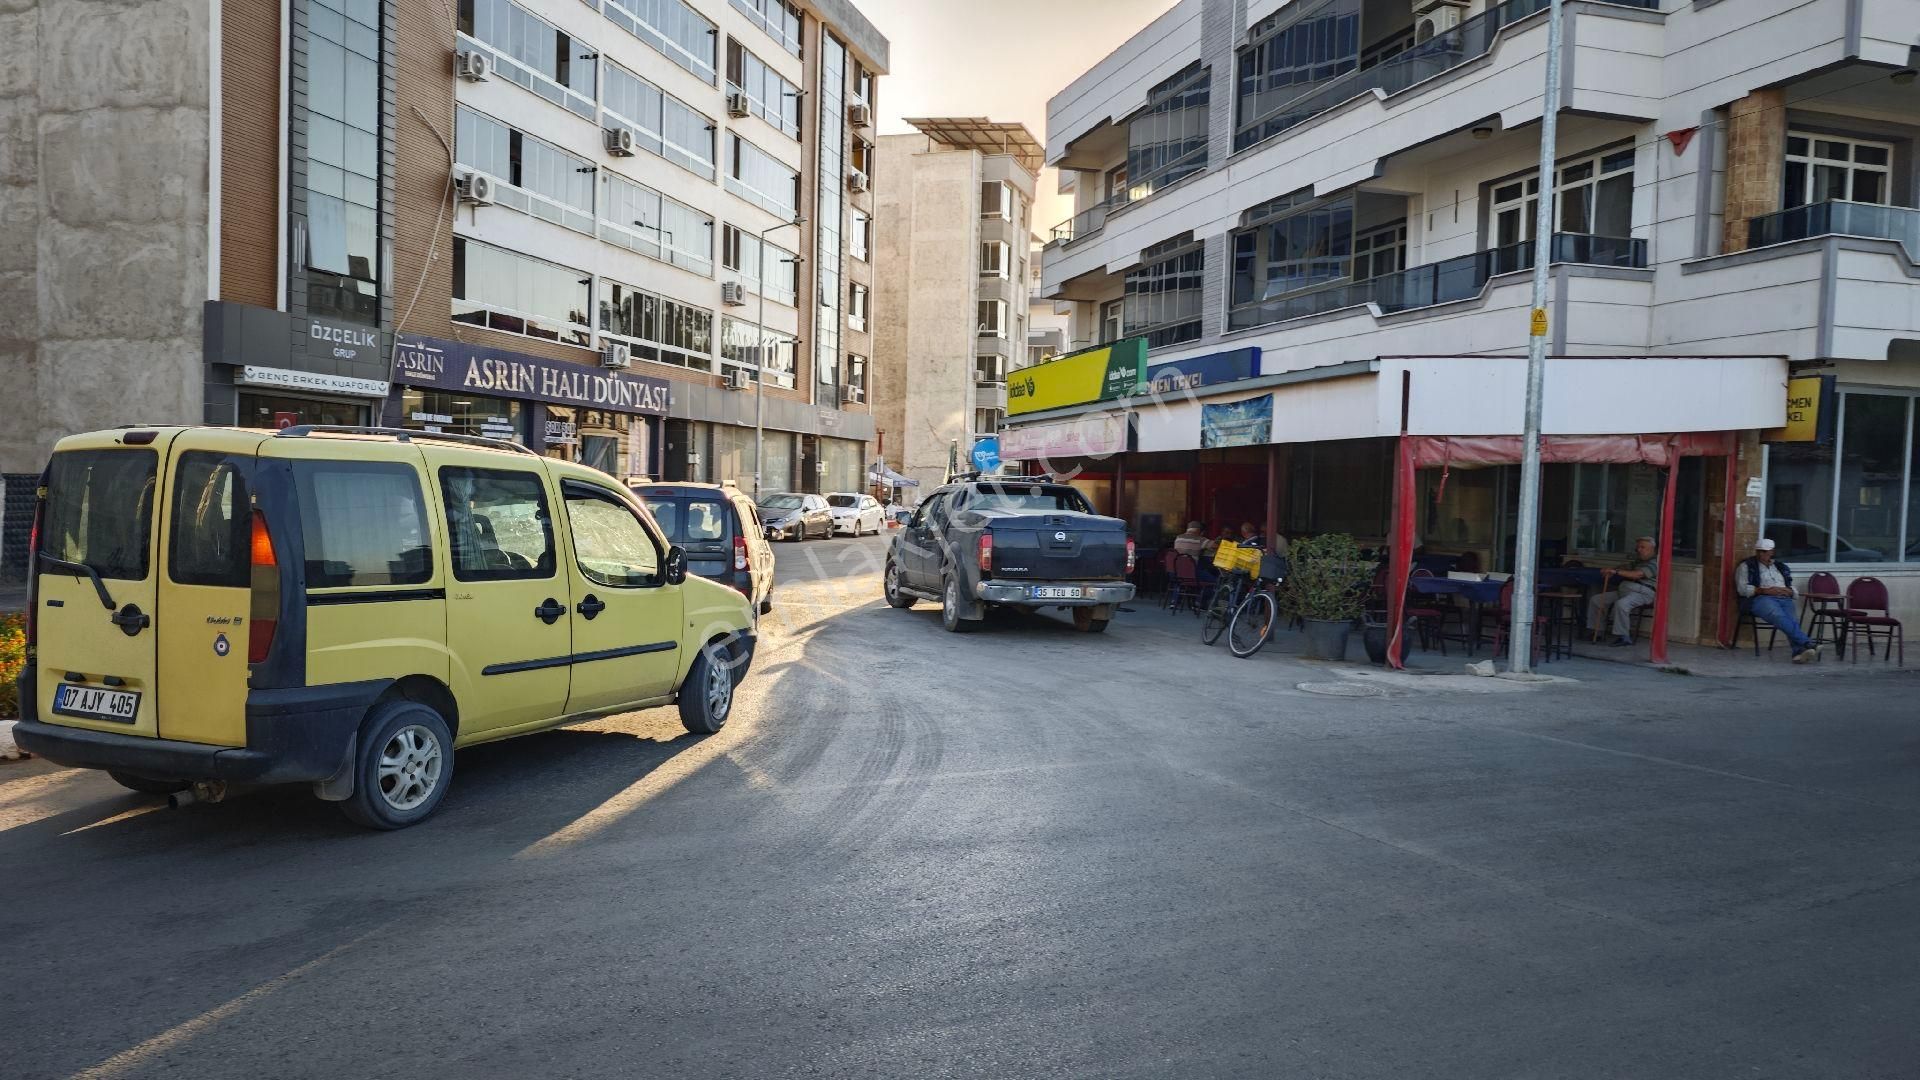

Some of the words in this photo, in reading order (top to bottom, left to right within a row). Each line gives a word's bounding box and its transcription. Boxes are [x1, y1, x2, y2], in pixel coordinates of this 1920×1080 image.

[311, 320, 377, 348] ÖZÇELİK
[333, 347, 357, 359] GRUP
[396, 350, 445, 374] ASRIN
[258, 372, 289, 384] GENÇ
[293, 374, 328, 386] ERKEK
[464, 357, 536, 394] ASRIN
[540, 366, 590, 401] HALI
[594, 371, 669, 412] DÜNYASI
[62, 688, 79, 707] 07
[80, 690, 106, 712] AJY
[109, 694, 134, 716] 405
